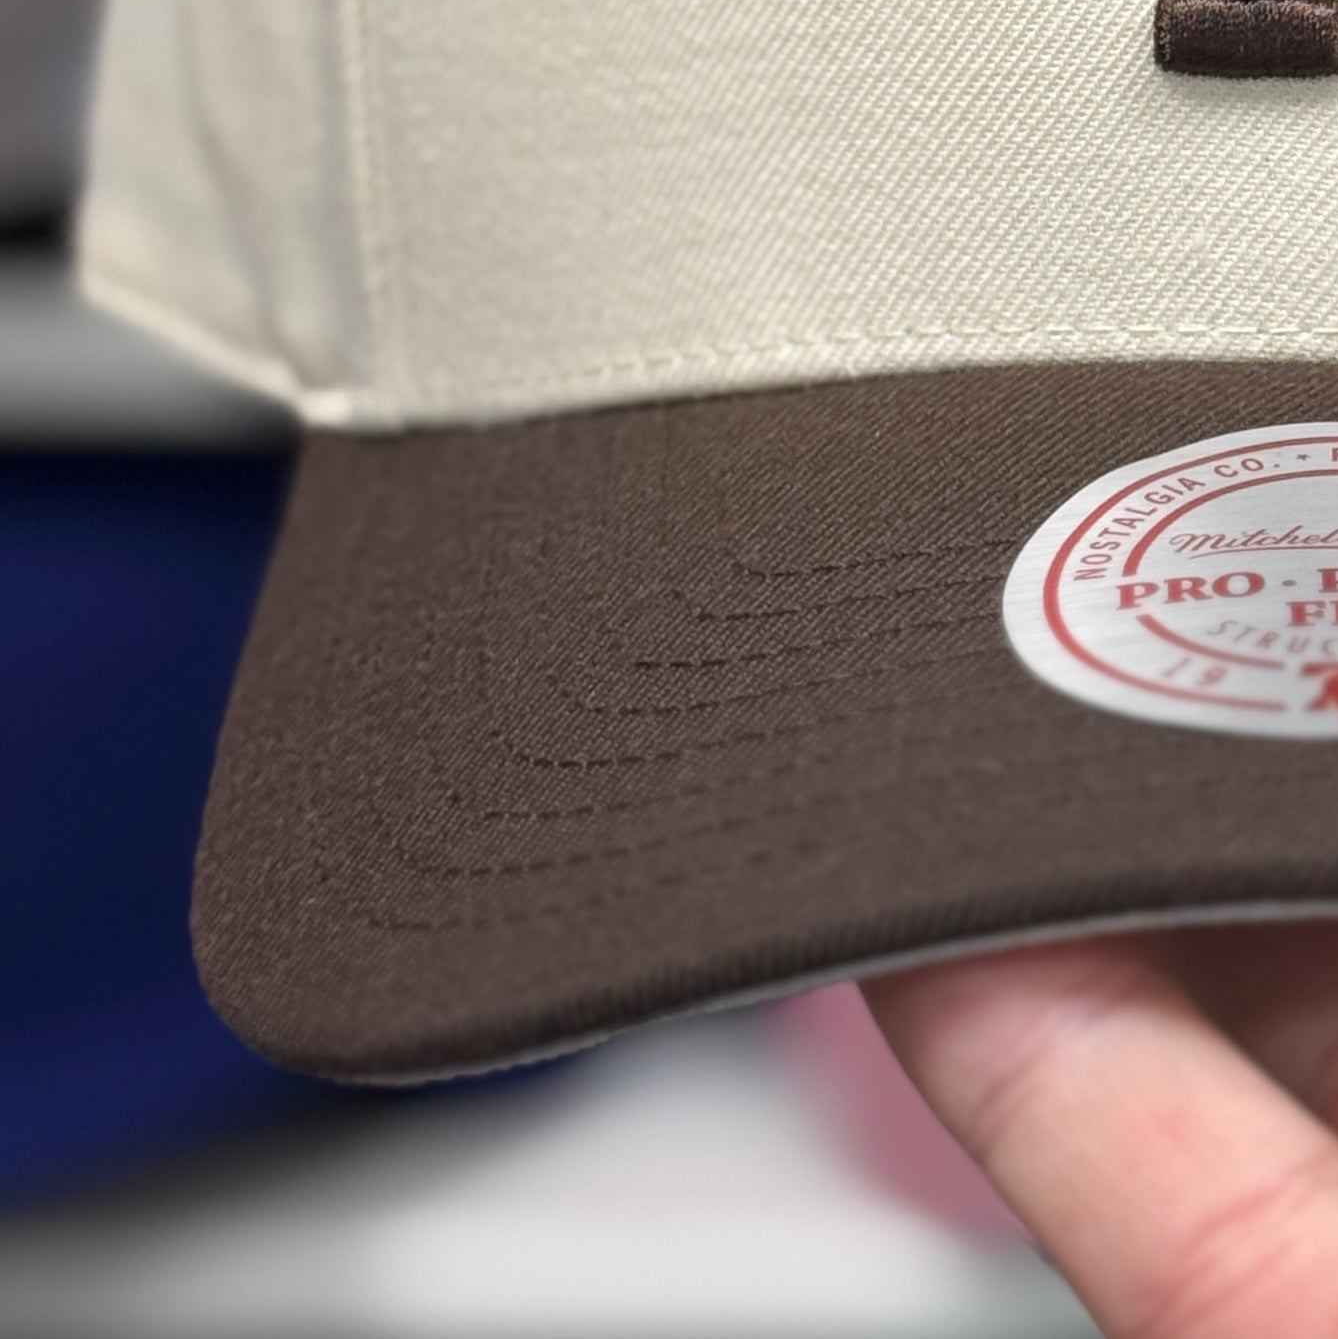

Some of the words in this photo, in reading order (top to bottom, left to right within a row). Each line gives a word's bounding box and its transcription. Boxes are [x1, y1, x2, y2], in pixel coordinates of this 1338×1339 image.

[1073, 477, 1206, 581] NOSTALGIA
[1213, 458, 1281, 479] CO.
[1115, 571, 1266, 611] PRO
